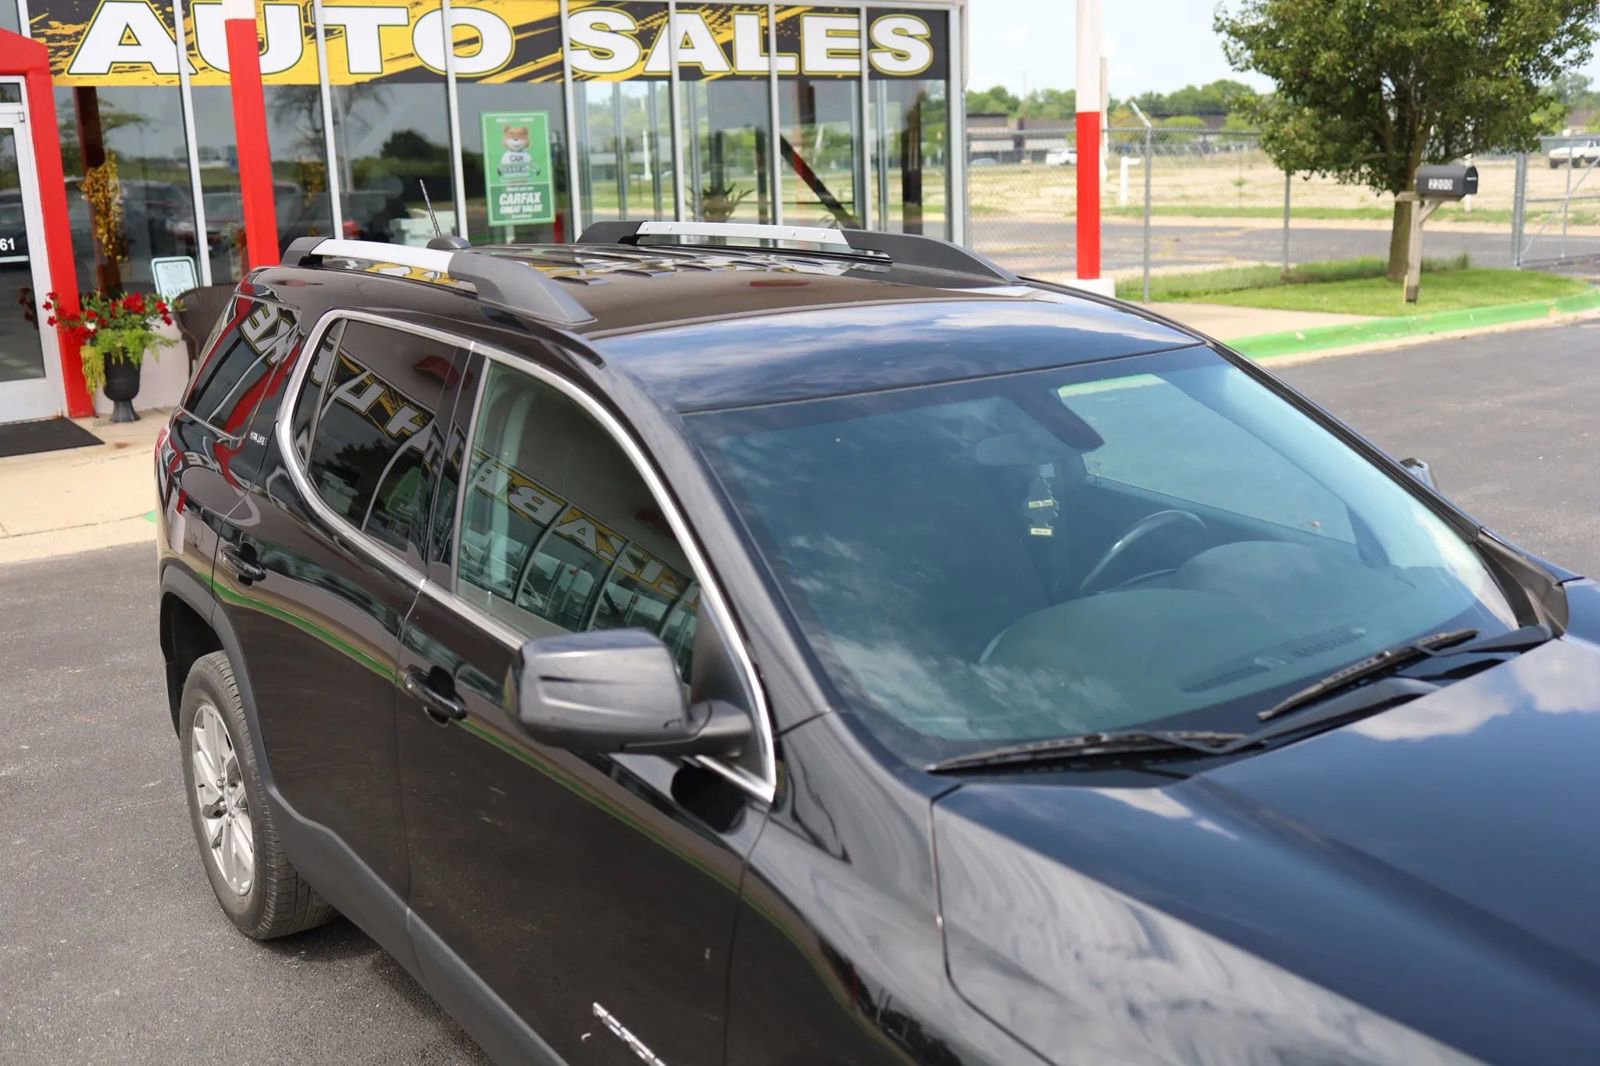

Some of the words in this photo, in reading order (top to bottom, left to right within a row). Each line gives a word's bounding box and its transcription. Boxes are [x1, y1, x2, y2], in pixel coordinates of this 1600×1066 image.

[67, 0, 516, 77] AUTO
[567, 7, 934, 76] SALES
[499, 192, 542, 206] CARFAX
